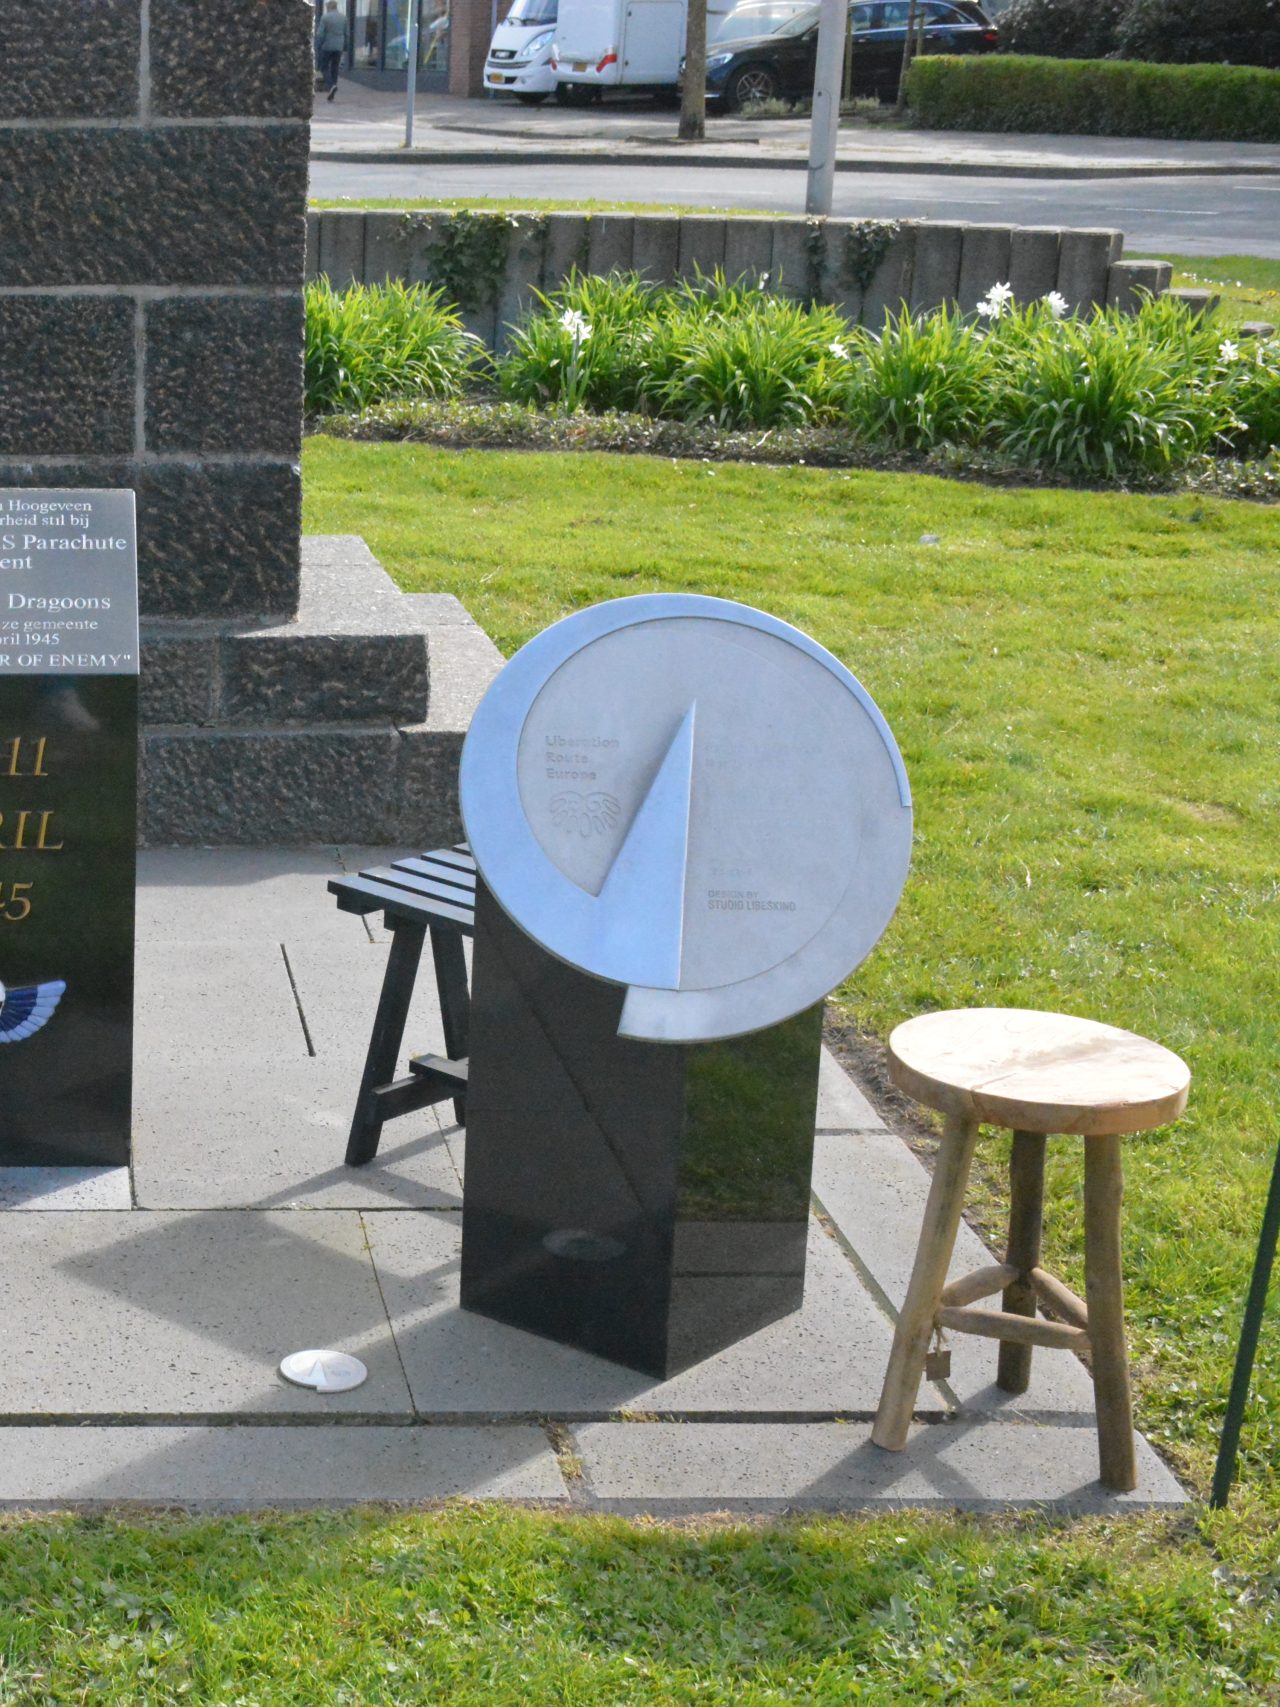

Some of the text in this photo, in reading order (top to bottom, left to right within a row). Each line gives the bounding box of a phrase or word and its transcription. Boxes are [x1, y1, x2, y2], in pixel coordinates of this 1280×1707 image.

[9, 500, 92, 513] Hoogeveen
[41, 515, 66, 526] stil
[70, 515, 90, 528] bij
[23, 534, 127, 551] Parachute
[8, 594, 111, 612] Dragoons
[24, 620, 98, 633] gemeente
[25, 634, 60, 645] 1945
[18, 654, 42, 666] OF
[49, 654, 131, 667] ENEMY"
[707, 899, 744, 910] STUDIO
